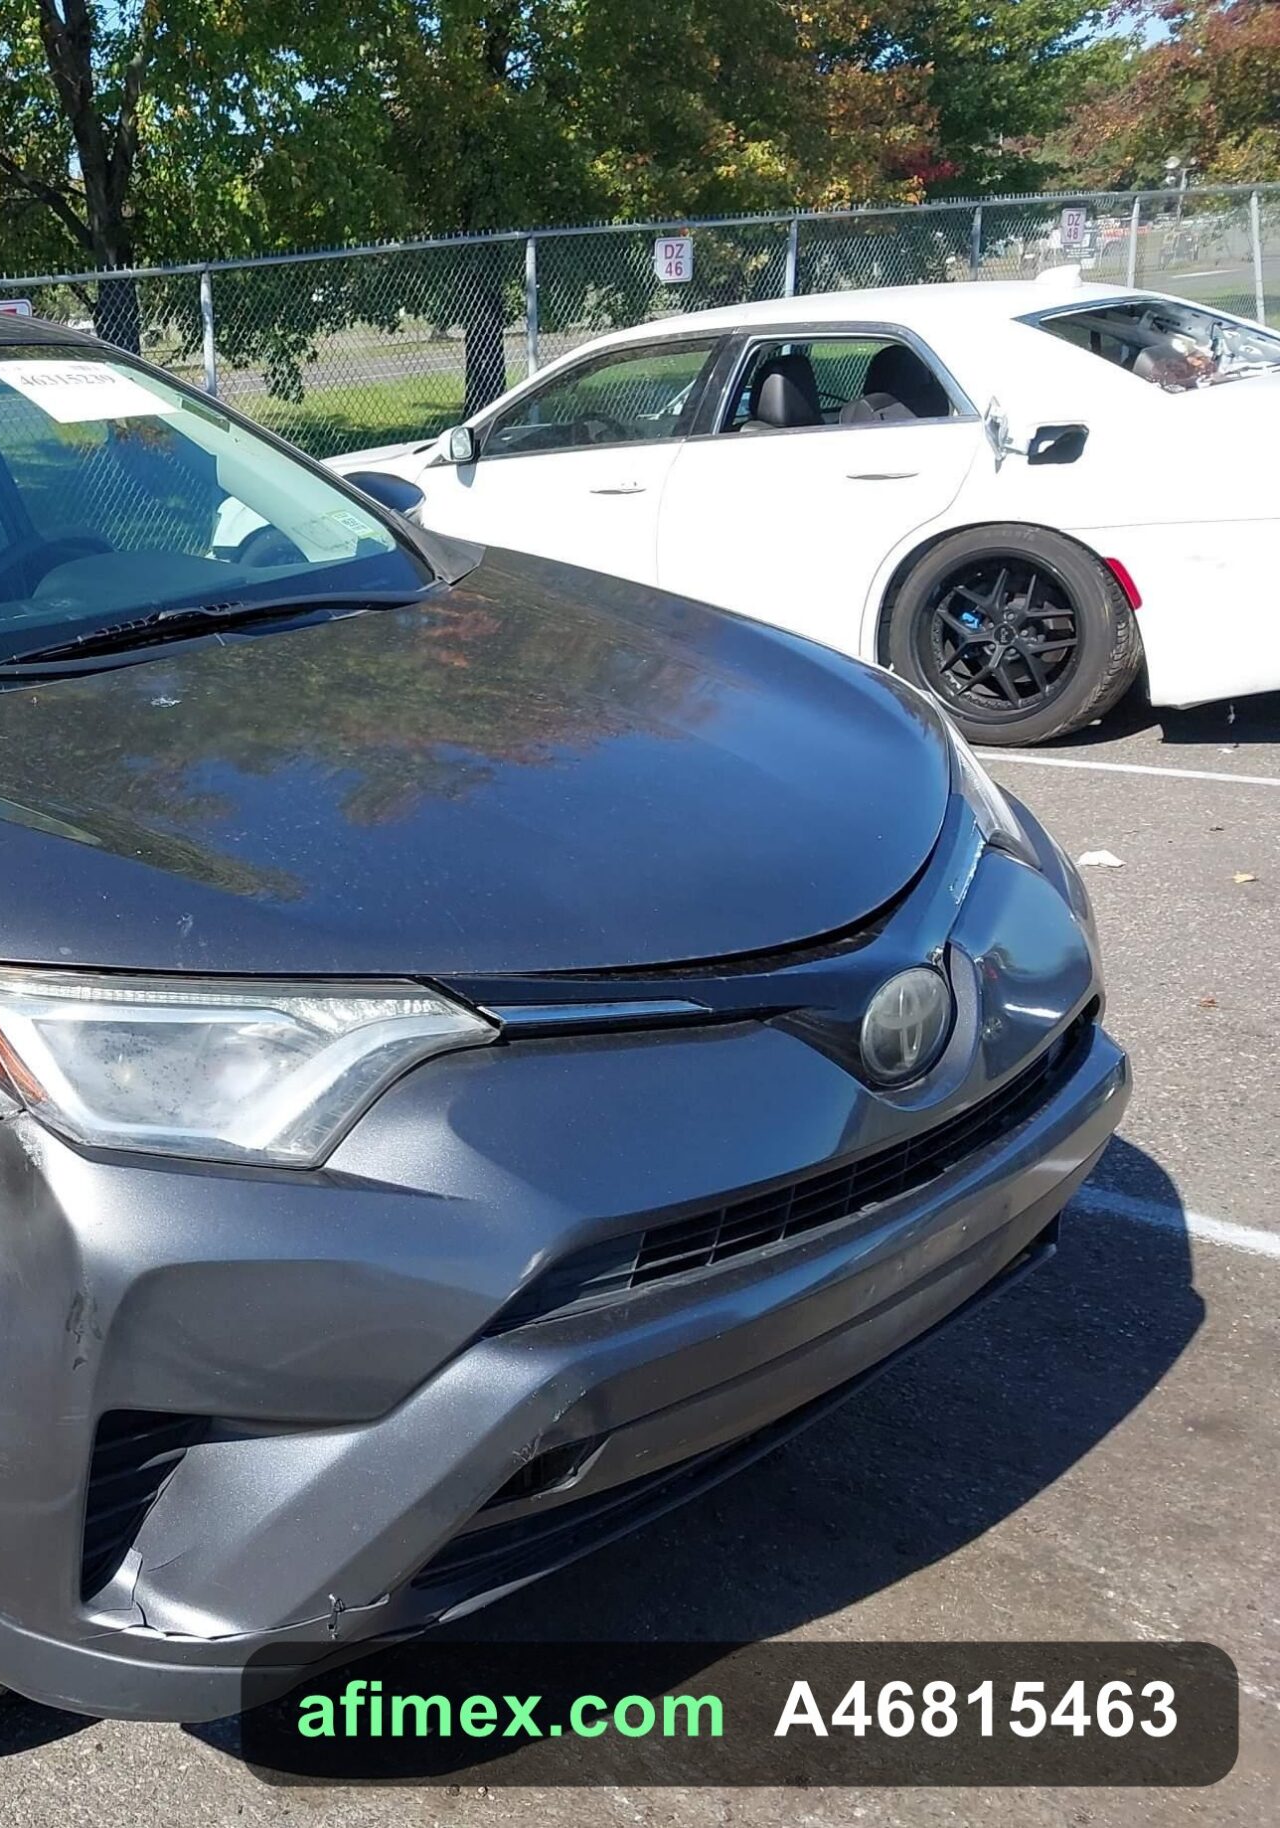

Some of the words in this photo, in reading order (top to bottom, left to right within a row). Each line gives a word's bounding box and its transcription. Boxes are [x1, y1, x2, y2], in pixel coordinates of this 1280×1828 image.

[1067, 213, 1081, 227] DZ
[1066, 227, 1079, 240] 48
[664, 243, 684, 260] DZ
[664, 260, 684, 277] 46
